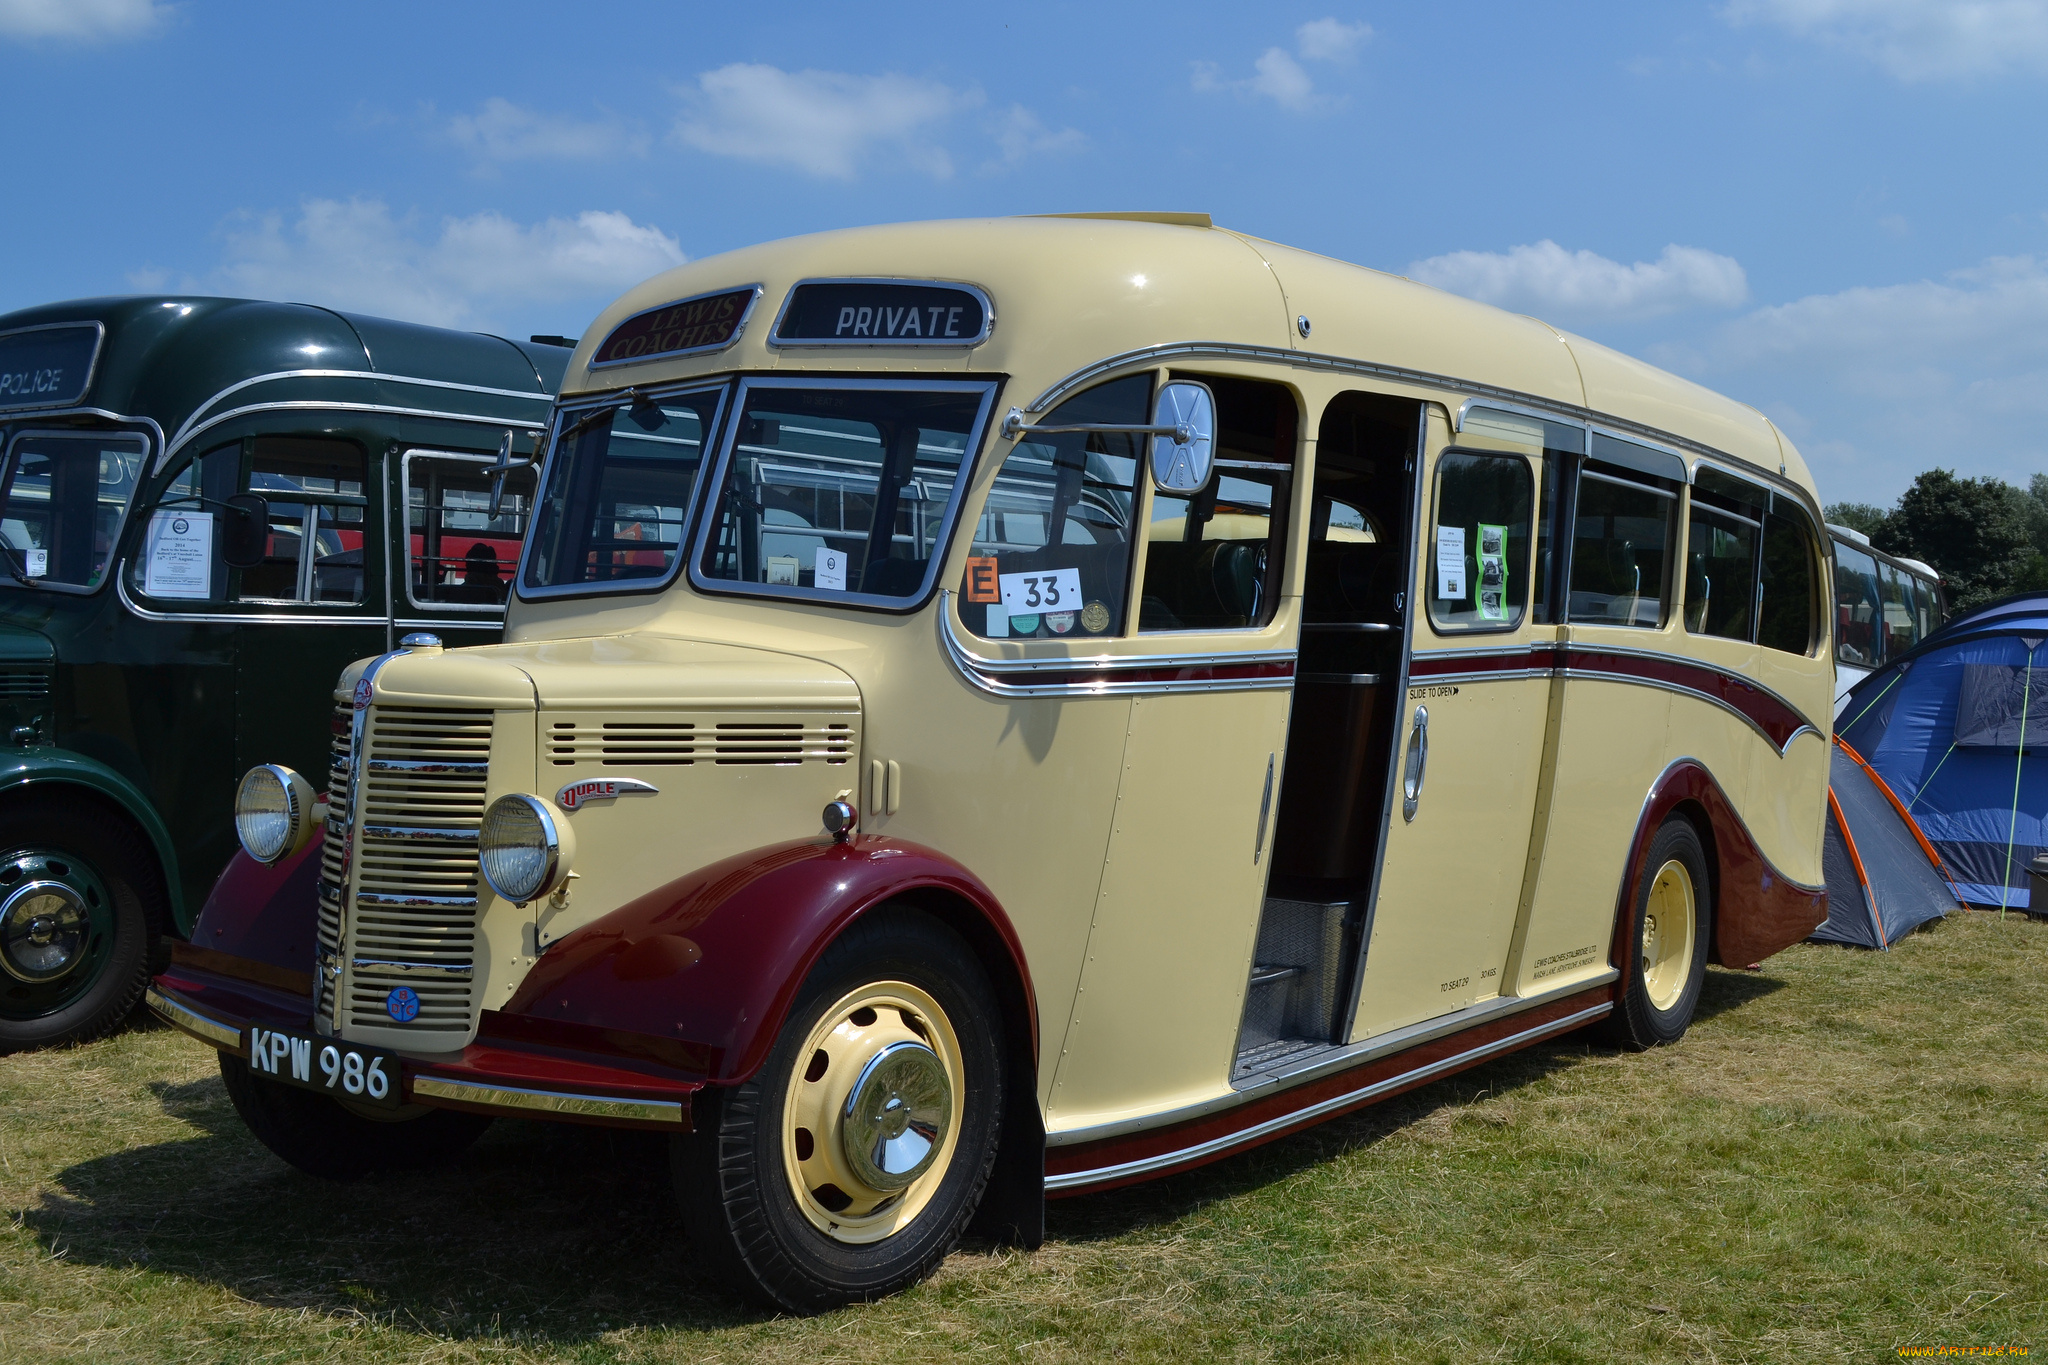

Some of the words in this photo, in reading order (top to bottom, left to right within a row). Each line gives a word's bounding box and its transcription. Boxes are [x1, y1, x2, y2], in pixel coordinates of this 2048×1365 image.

[647, 295, 739, 333] LEWIS
[835, 306, 964, 337] PRIVATE
[609, 319, 733, 360] COACHES
[0, 368, 63, 395] POLICE
[972, 565, 994, 594] E
[1023, 575, 1060, 608] 33
[1409, 688, 1426, 700] SLIDE
[1428, 687, 1437, 698] TO
[1437, 686, 1453, 697] OPEN
[563, 782, 615, 807] DUPLE
[1480, 970, 1487, 979] 30
[1533, 957, 1548, 969] LEWIS
[1440, 982, 1448, 992] TO
[1448, 978, 1462, 991] SEAT
[1461, 976, 1470, 987] 29
[251, 1027, 311, 1082] KPW
[319, 1045, 389, 1100] 986
